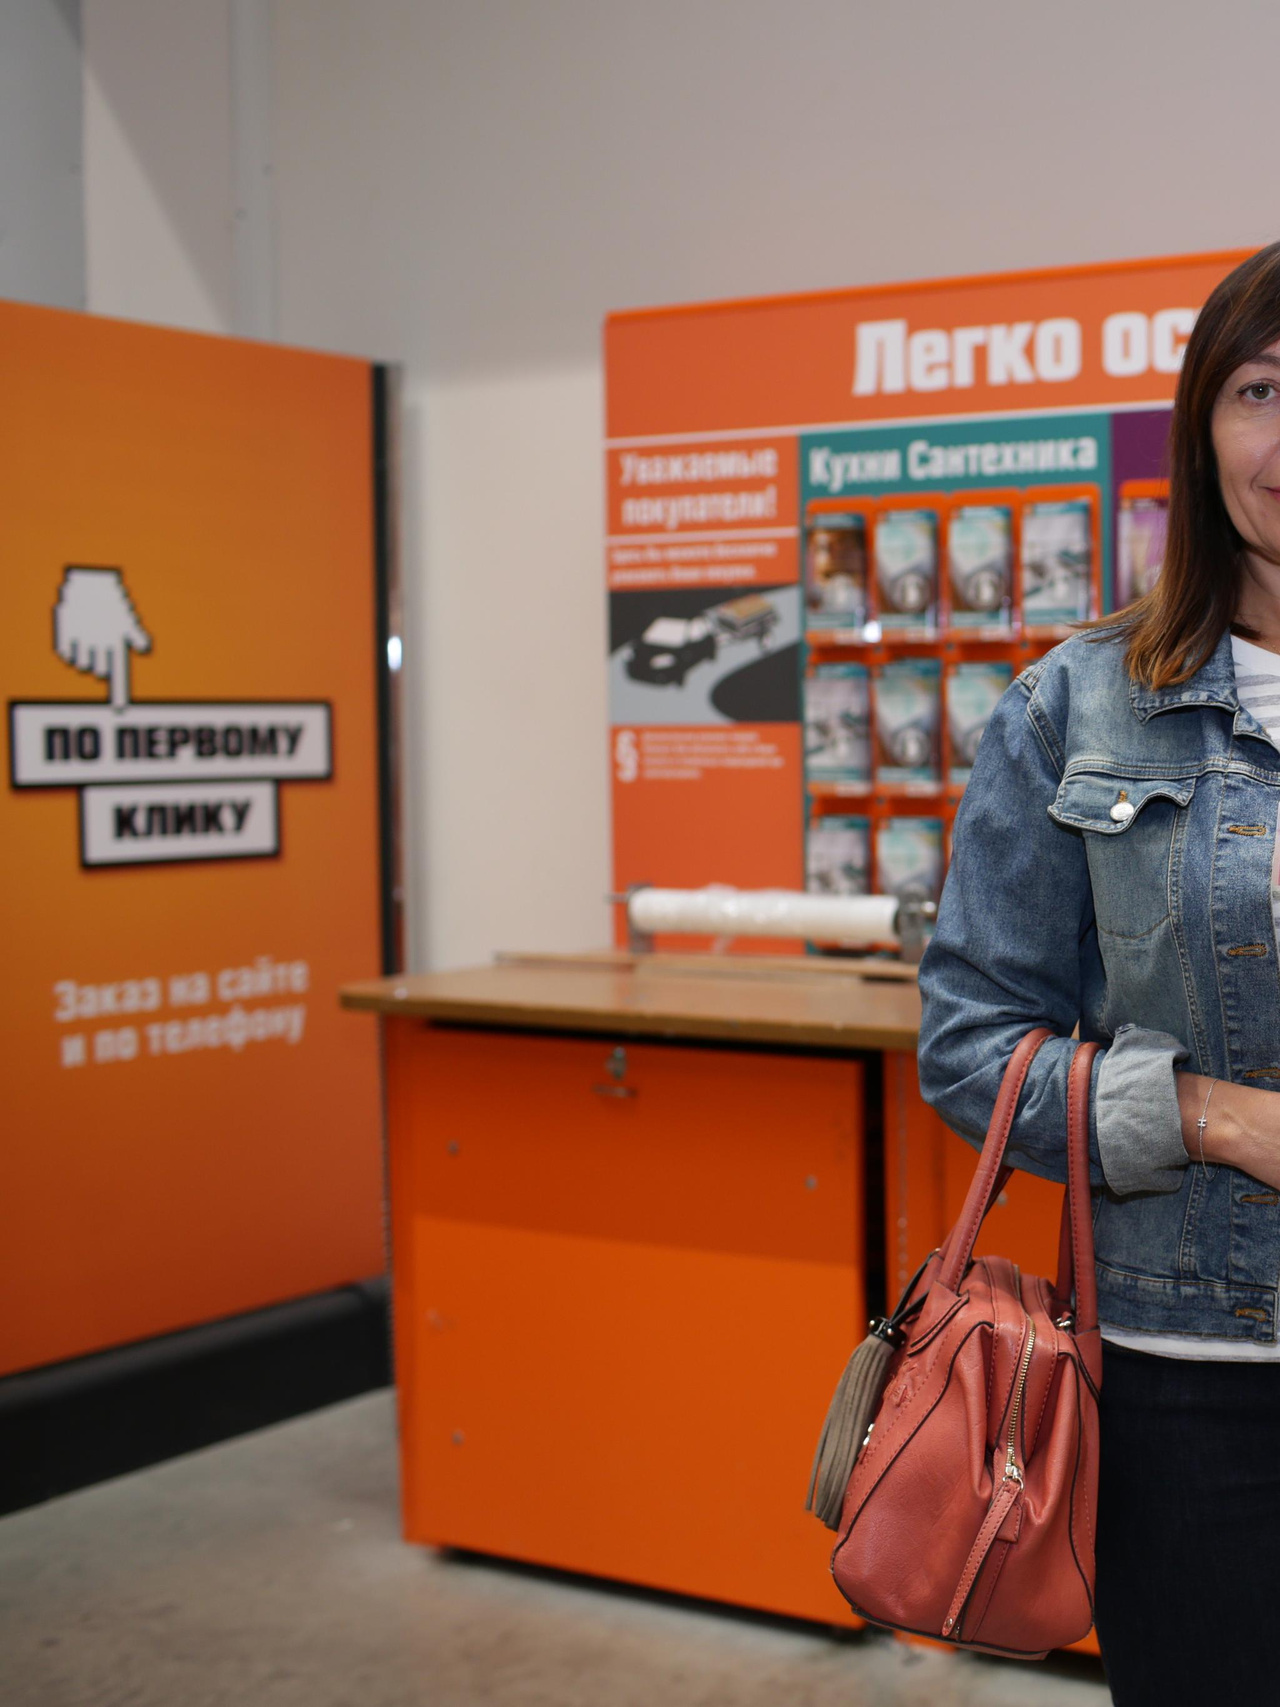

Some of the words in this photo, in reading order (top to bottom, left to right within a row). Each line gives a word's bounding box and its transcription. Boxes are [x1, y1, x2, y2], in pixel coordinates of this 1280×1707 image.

[851, 317, 1083, 397] Легко
[619, 448, 779, 486] Уважаемые
[808, 446, 900, 493] Кухни
[907, 436, 1098, 480] Сантехника
[45, 726, 100, 761] ПО
[116, 724, 304, 759] ПЕРВОМУ
[114, 801, 252, 838] КЛИКУ
[54, 976, 159, 1022] Заказ
[168, 970, 210, 1008] на
[217, 955, 310, 999] сайте
[61, 1034, 84, 1068] и
[95, 1027, 138, 1063] по
[146, 1004, 307, 1056] телефону
